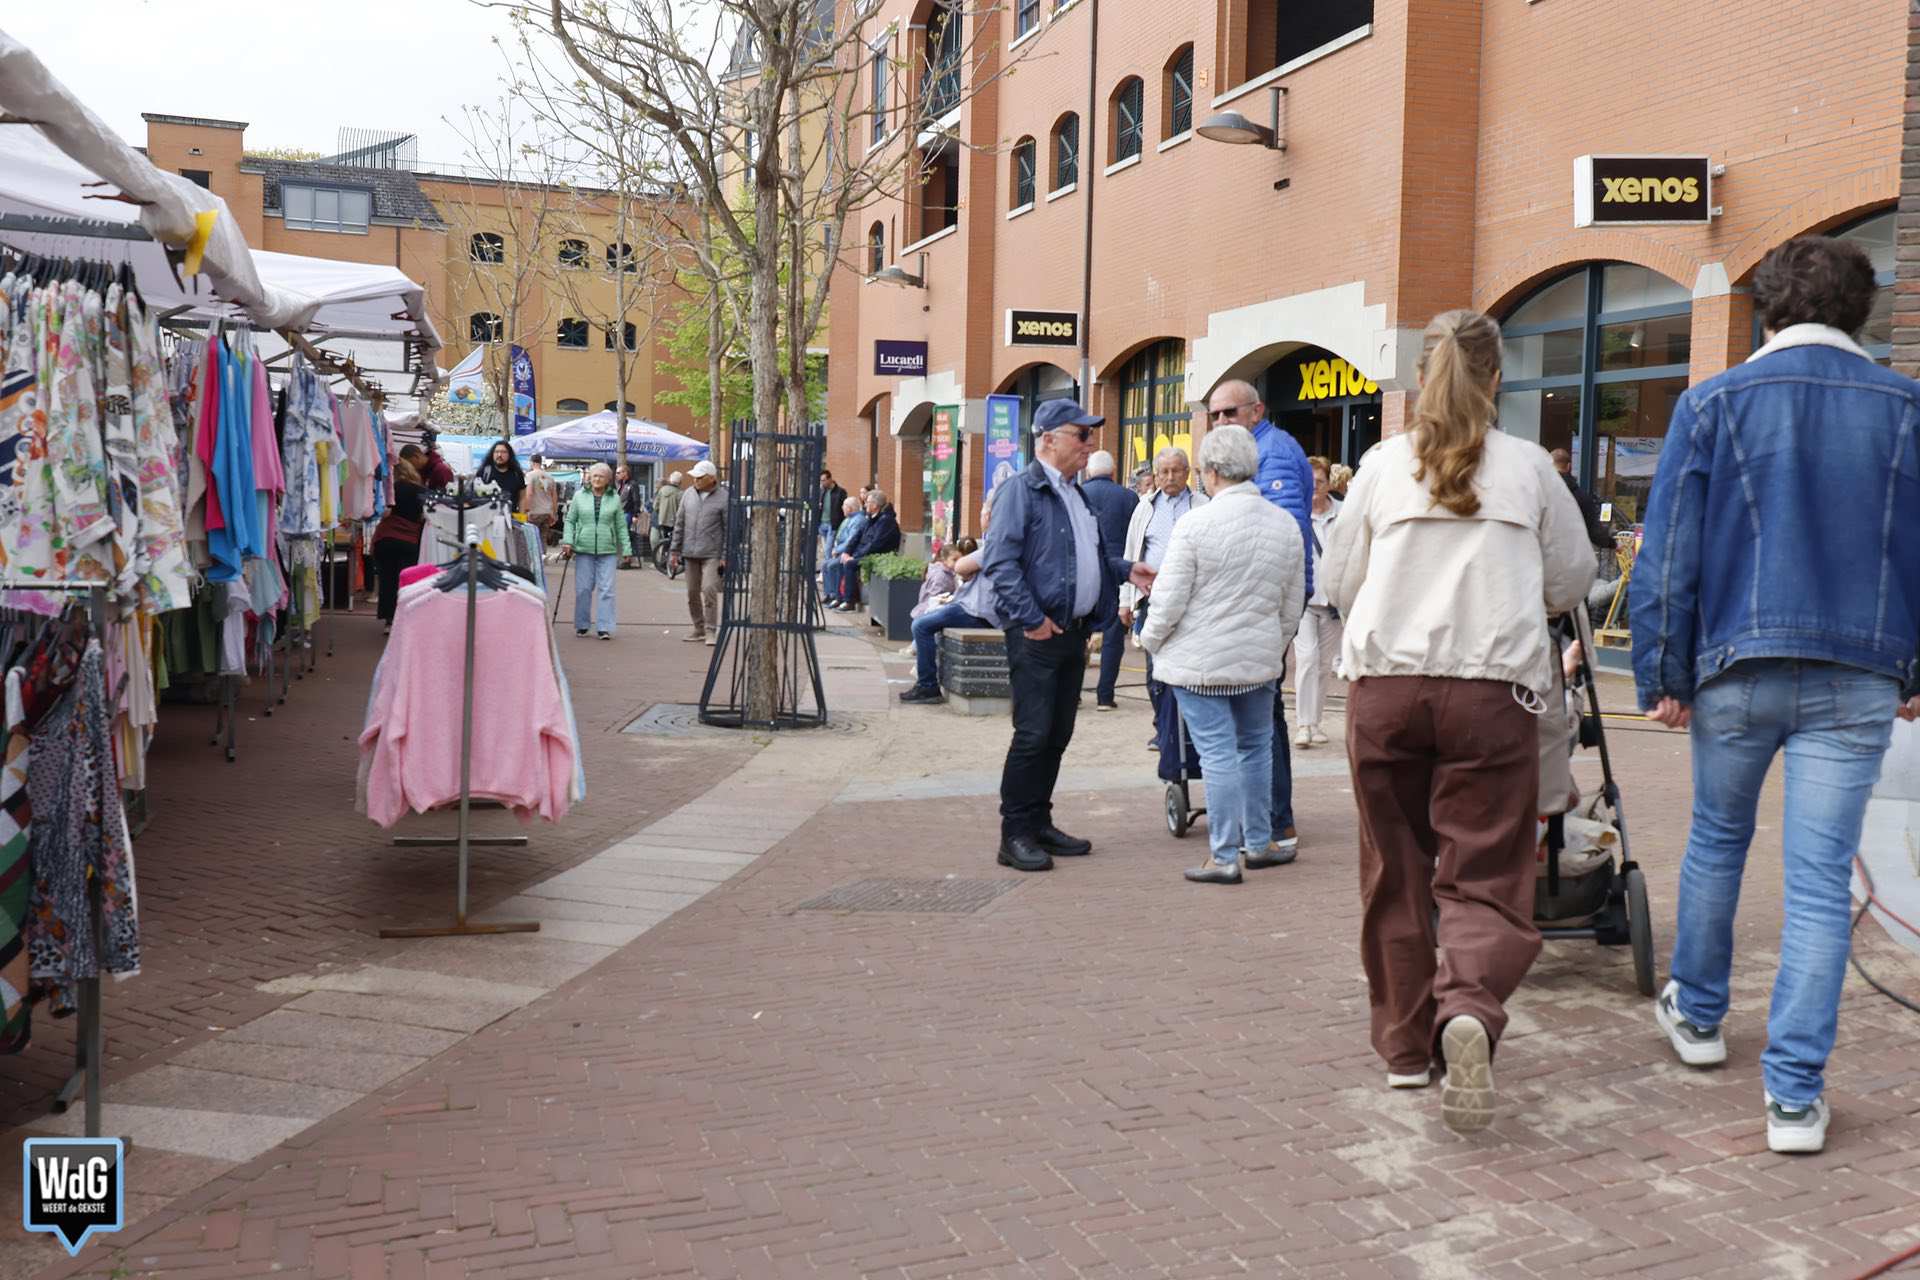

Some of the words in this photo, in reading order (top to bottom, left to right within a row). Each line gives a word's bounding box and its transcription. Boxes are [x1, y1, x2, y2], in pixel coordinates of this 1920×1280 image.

[1601, 176, 1700, 204] xenos
[1017, 320, 1073, 337] xenos
[880, 353, 924, 365] Lucardi
